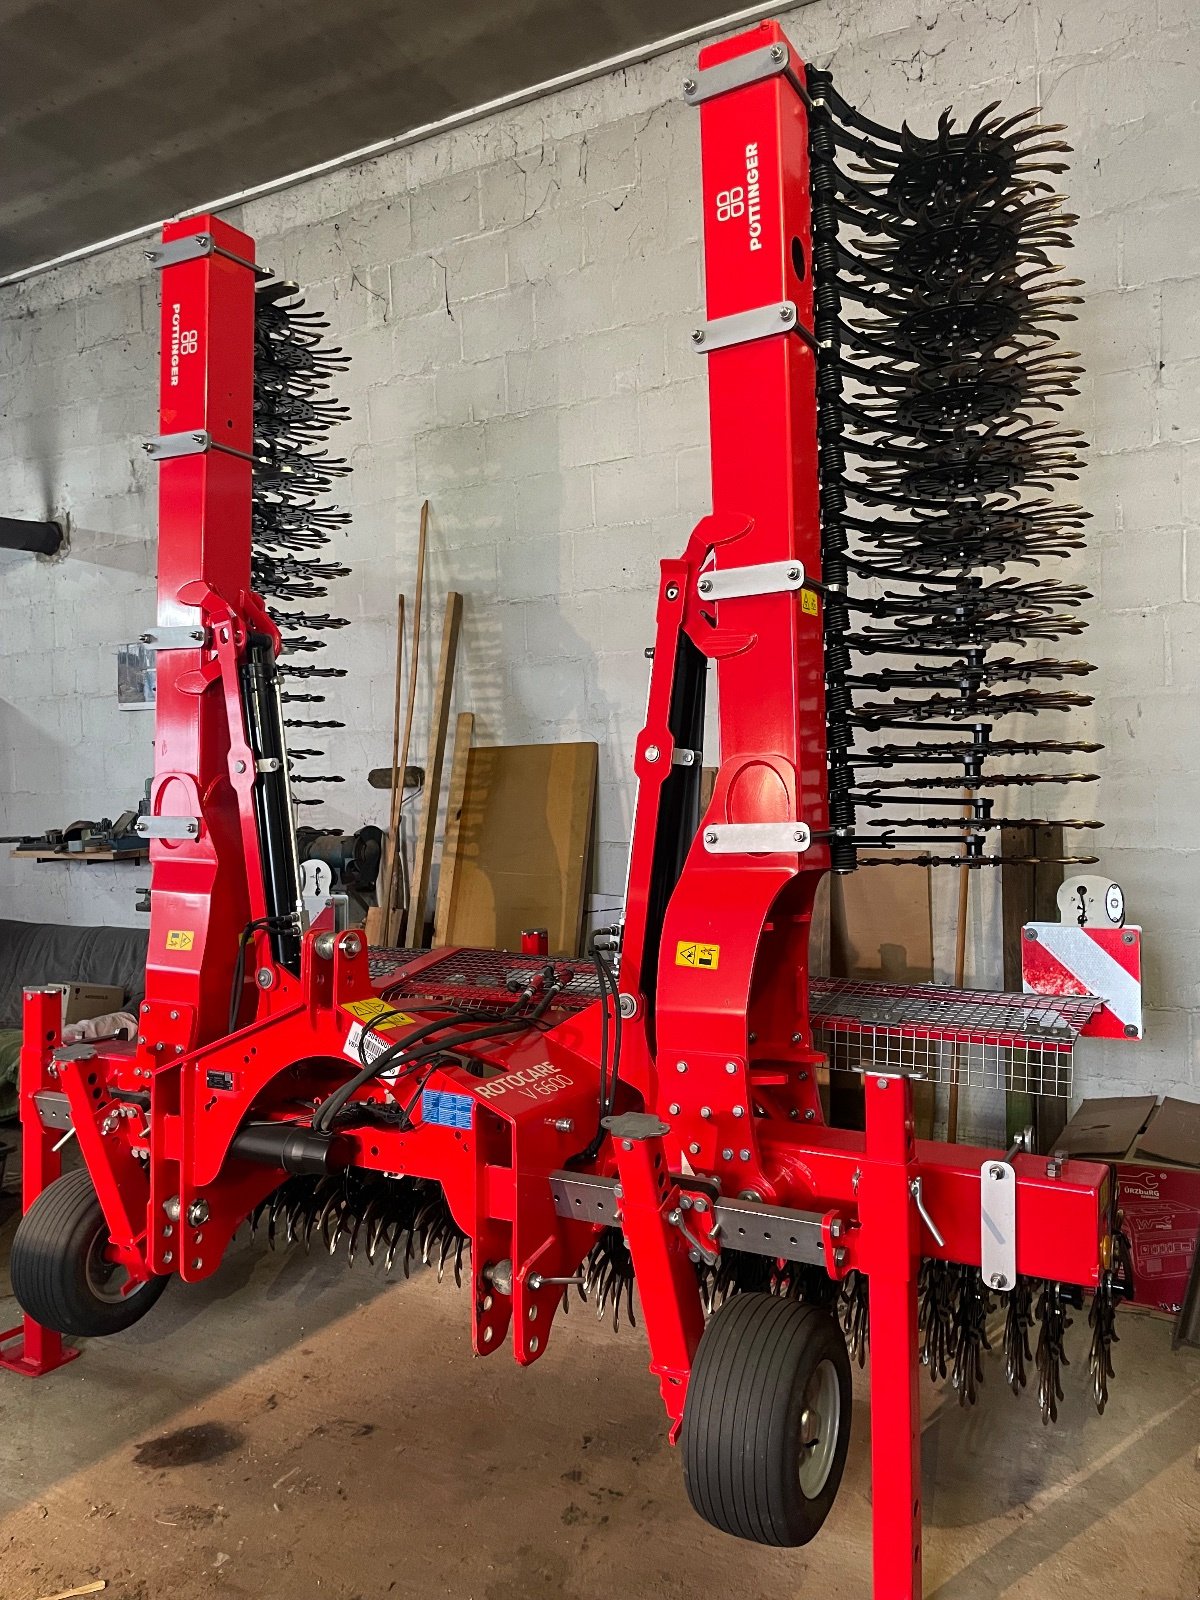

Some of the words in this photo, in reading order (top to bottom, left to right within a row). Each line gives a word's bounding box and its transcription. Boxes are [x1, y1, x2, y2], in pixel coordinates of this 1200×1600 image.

[745, 142, 762, 252] PÖTTINGER
[474, 1061, 562, 1099] ROTOCARE
[518, 1087, 538, 1100] V
[534, 1074, 574, 1095] 6600
